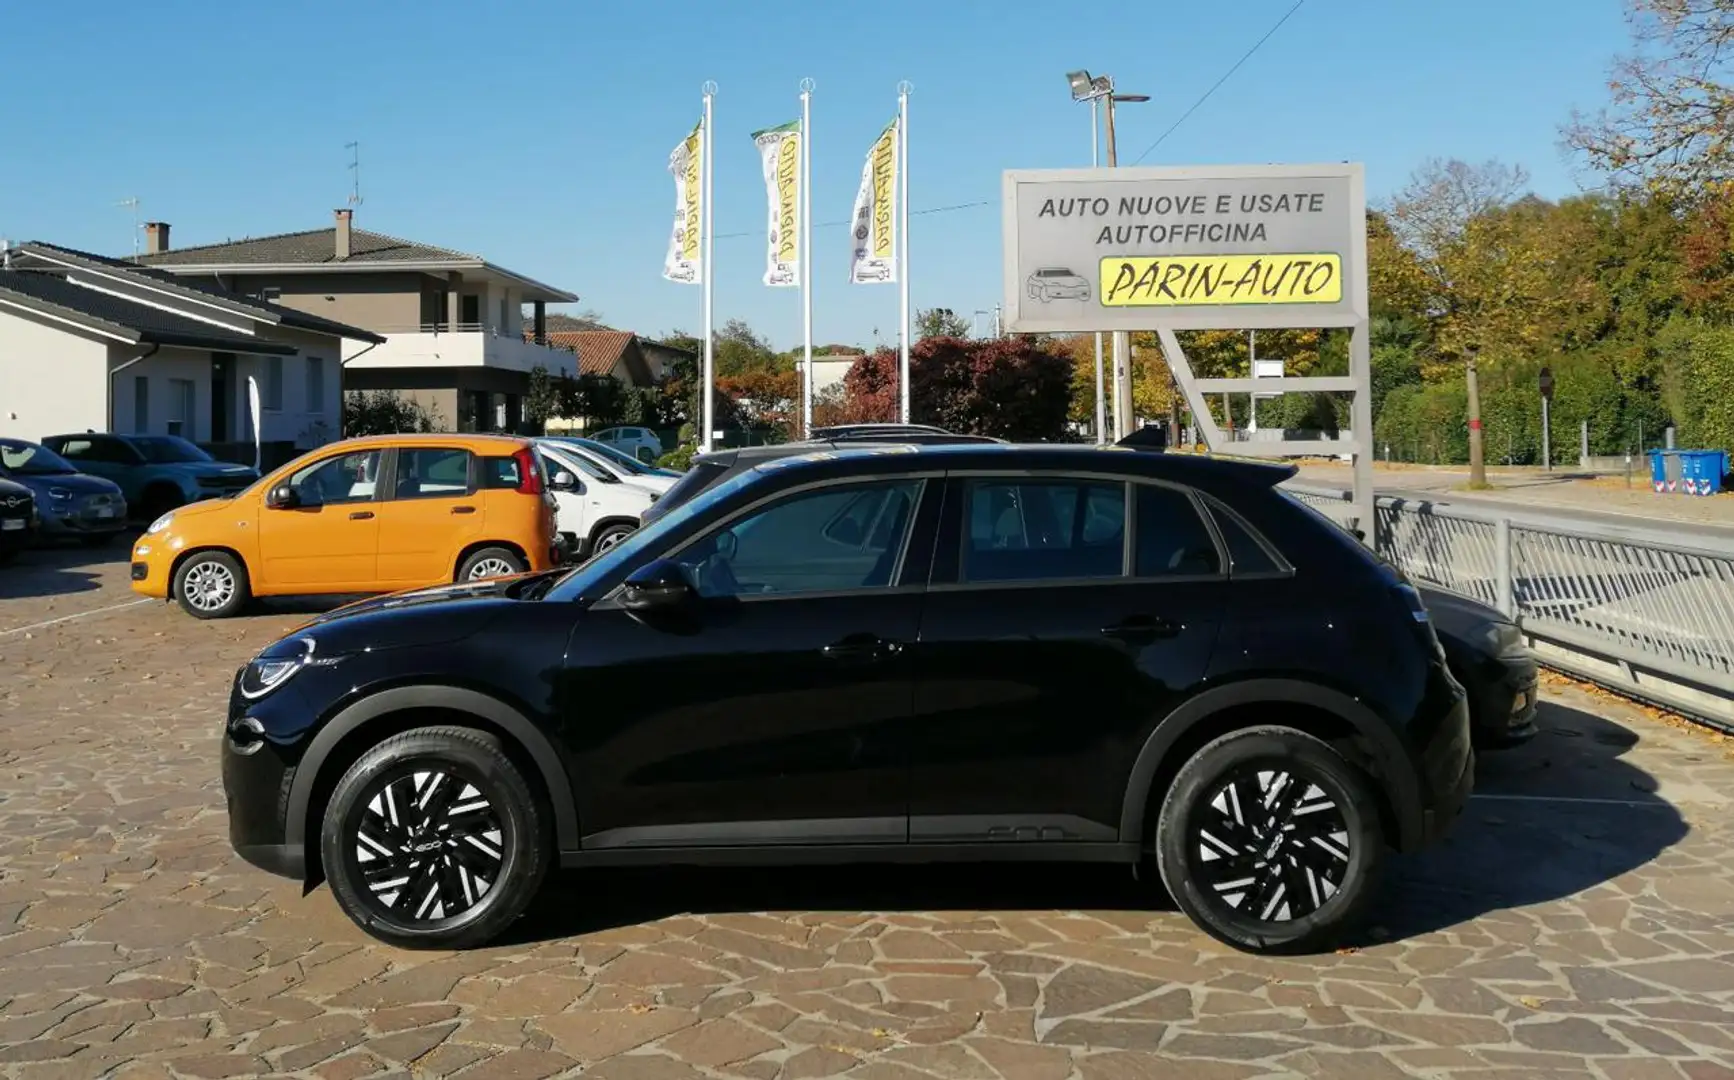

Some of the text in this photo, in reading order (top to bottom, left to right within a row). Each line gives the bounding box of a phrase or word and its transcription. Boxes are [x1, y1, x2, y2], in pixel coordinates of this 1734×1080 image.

[1039, 193, 1325, 218] AUTO NUOVE E USATE
[1096, 223, 1268, 244] AUTOFFICINA
[1108, 258, 1334, 301] PARIN-AUTO
